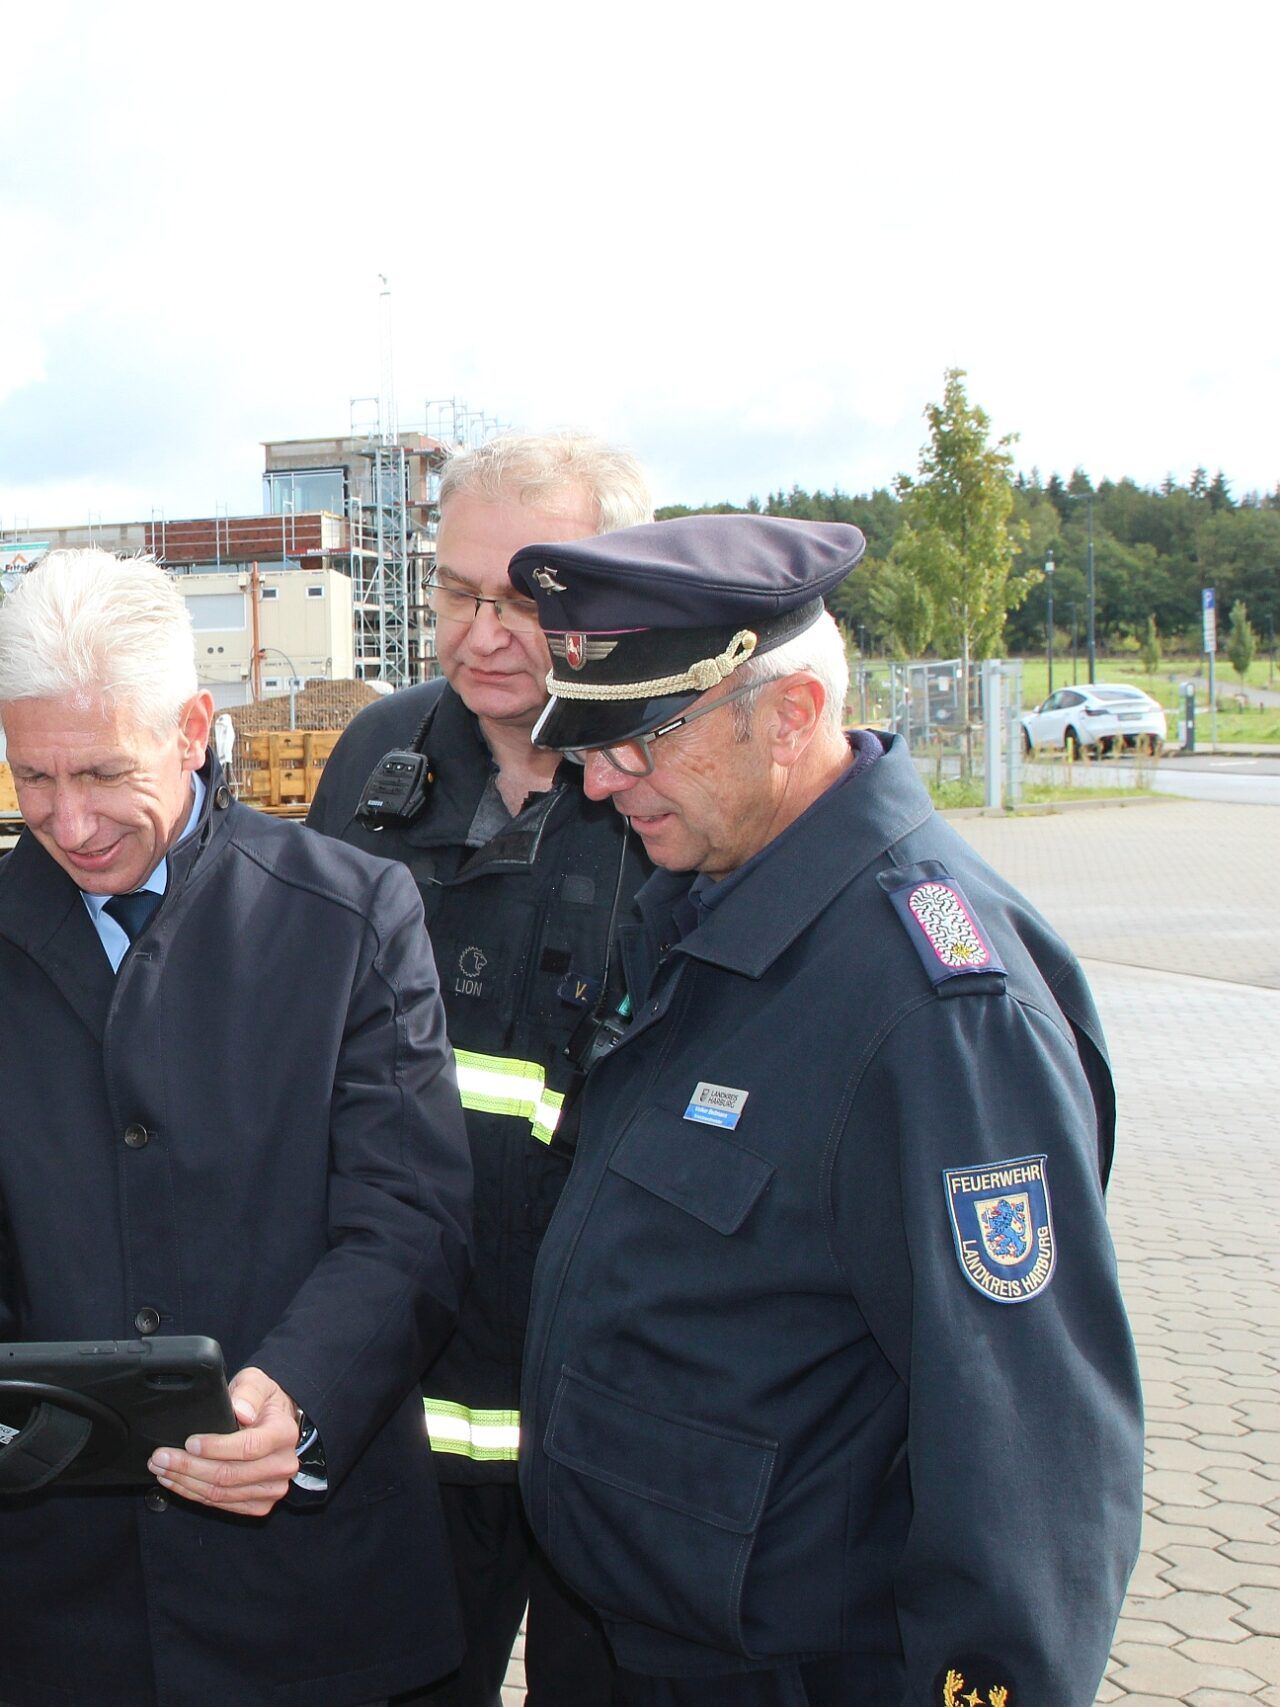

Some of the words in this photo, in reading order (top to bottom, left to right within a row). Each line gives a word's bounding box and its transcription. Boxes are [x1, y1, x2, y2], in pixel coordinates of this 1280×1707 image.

[455, 978, 483, 997] LION
[951, 1164, 1041, 1194] FEUERWEHR
[962, 1239, 1022, 1297] LANDKREIS
[1021, 1225, 1052, 1293] HARBURG
